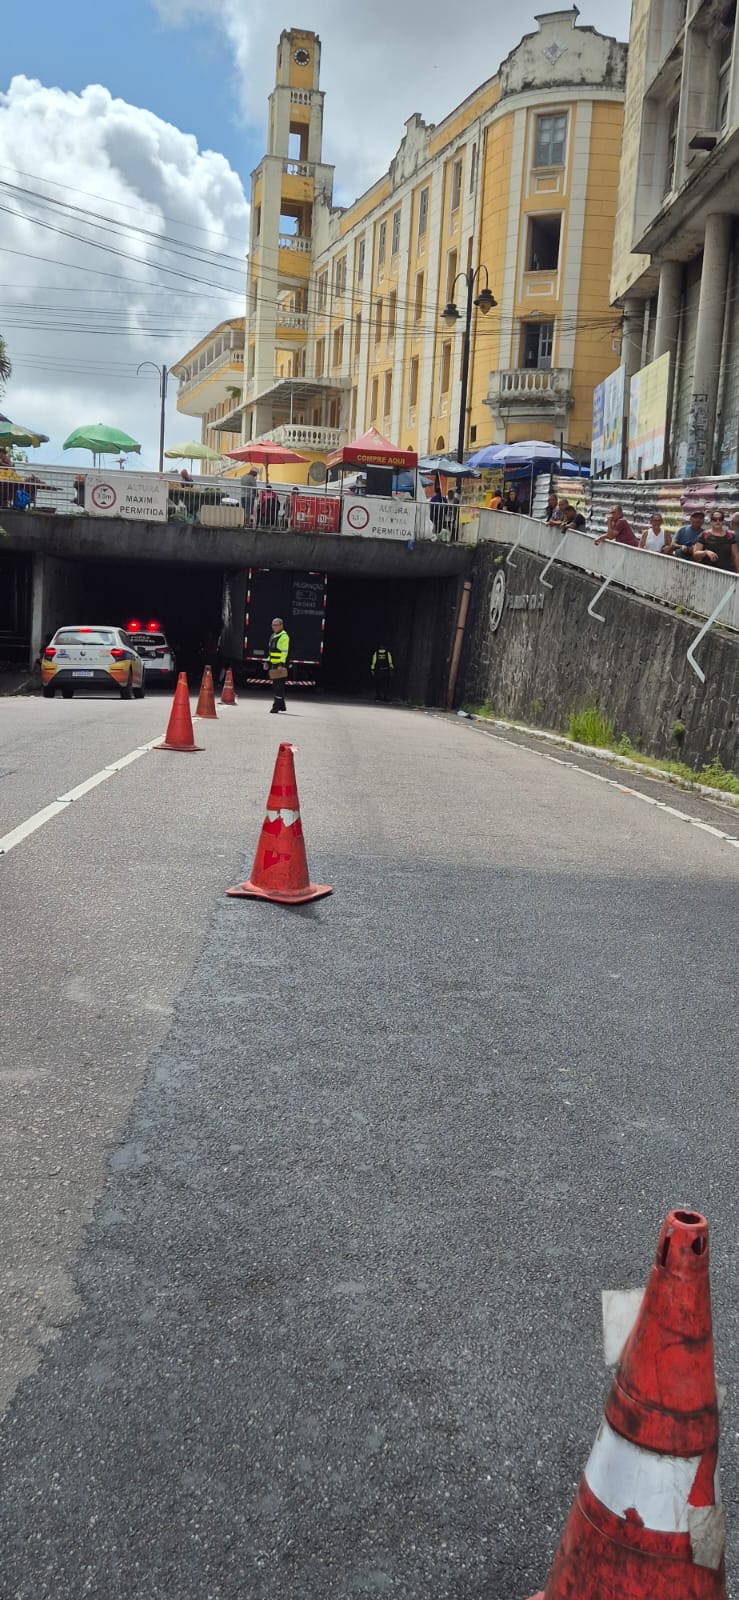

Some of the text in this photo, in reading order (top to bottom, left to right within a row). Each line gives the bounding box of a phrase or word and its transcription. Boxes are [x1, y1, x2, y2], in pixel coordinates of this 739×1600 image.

[357, 454, 405, 465] COMPRE AQUI
[120, 506, 164, 516] PERMITIDA
[372, 527, 412, 537] PERMITIDA
